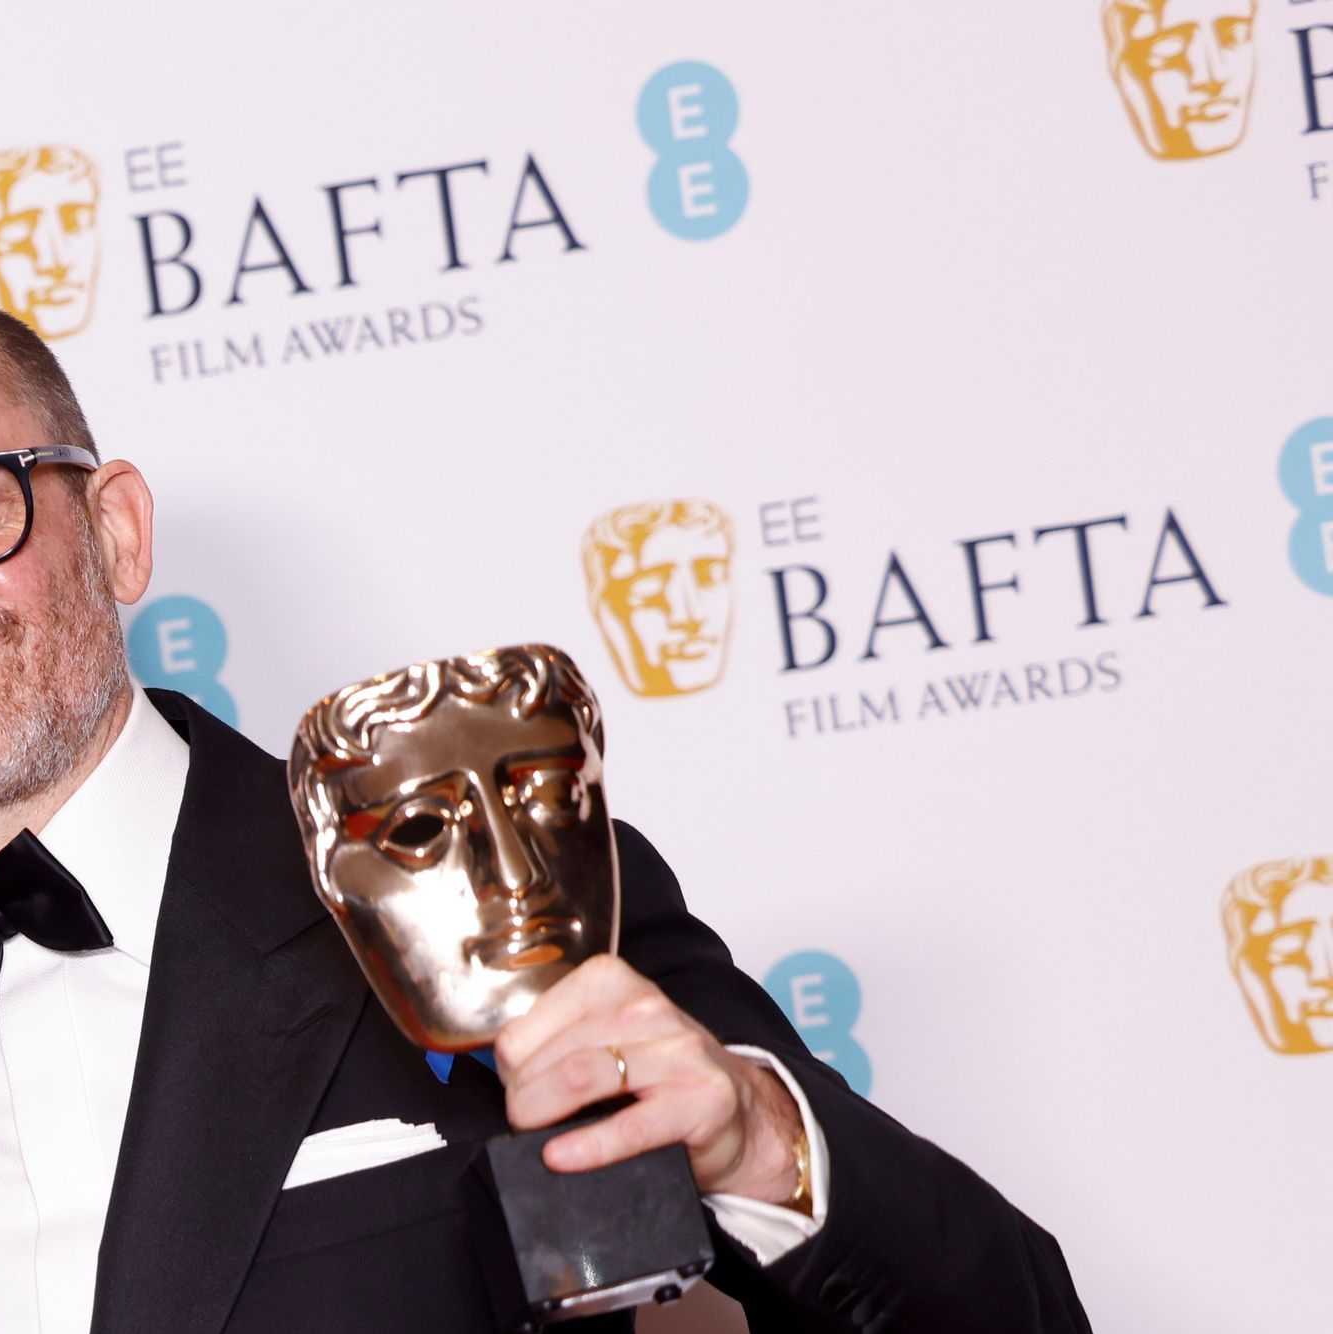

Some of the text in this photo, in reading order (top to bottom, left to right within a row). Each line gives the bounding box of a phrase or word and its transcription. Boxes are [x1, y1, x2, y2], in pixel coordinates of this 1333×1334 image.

[125, 141, 187, 193] EE
[132, 152, 589, 319] BAFTA
[148, 296, 485, 384] FILM AWARDS
[758, 496, 823, 547] EE
[767, 507, 1229, 674] BAFTA
[783, 651, 1124, 739] FILM AWARDS
